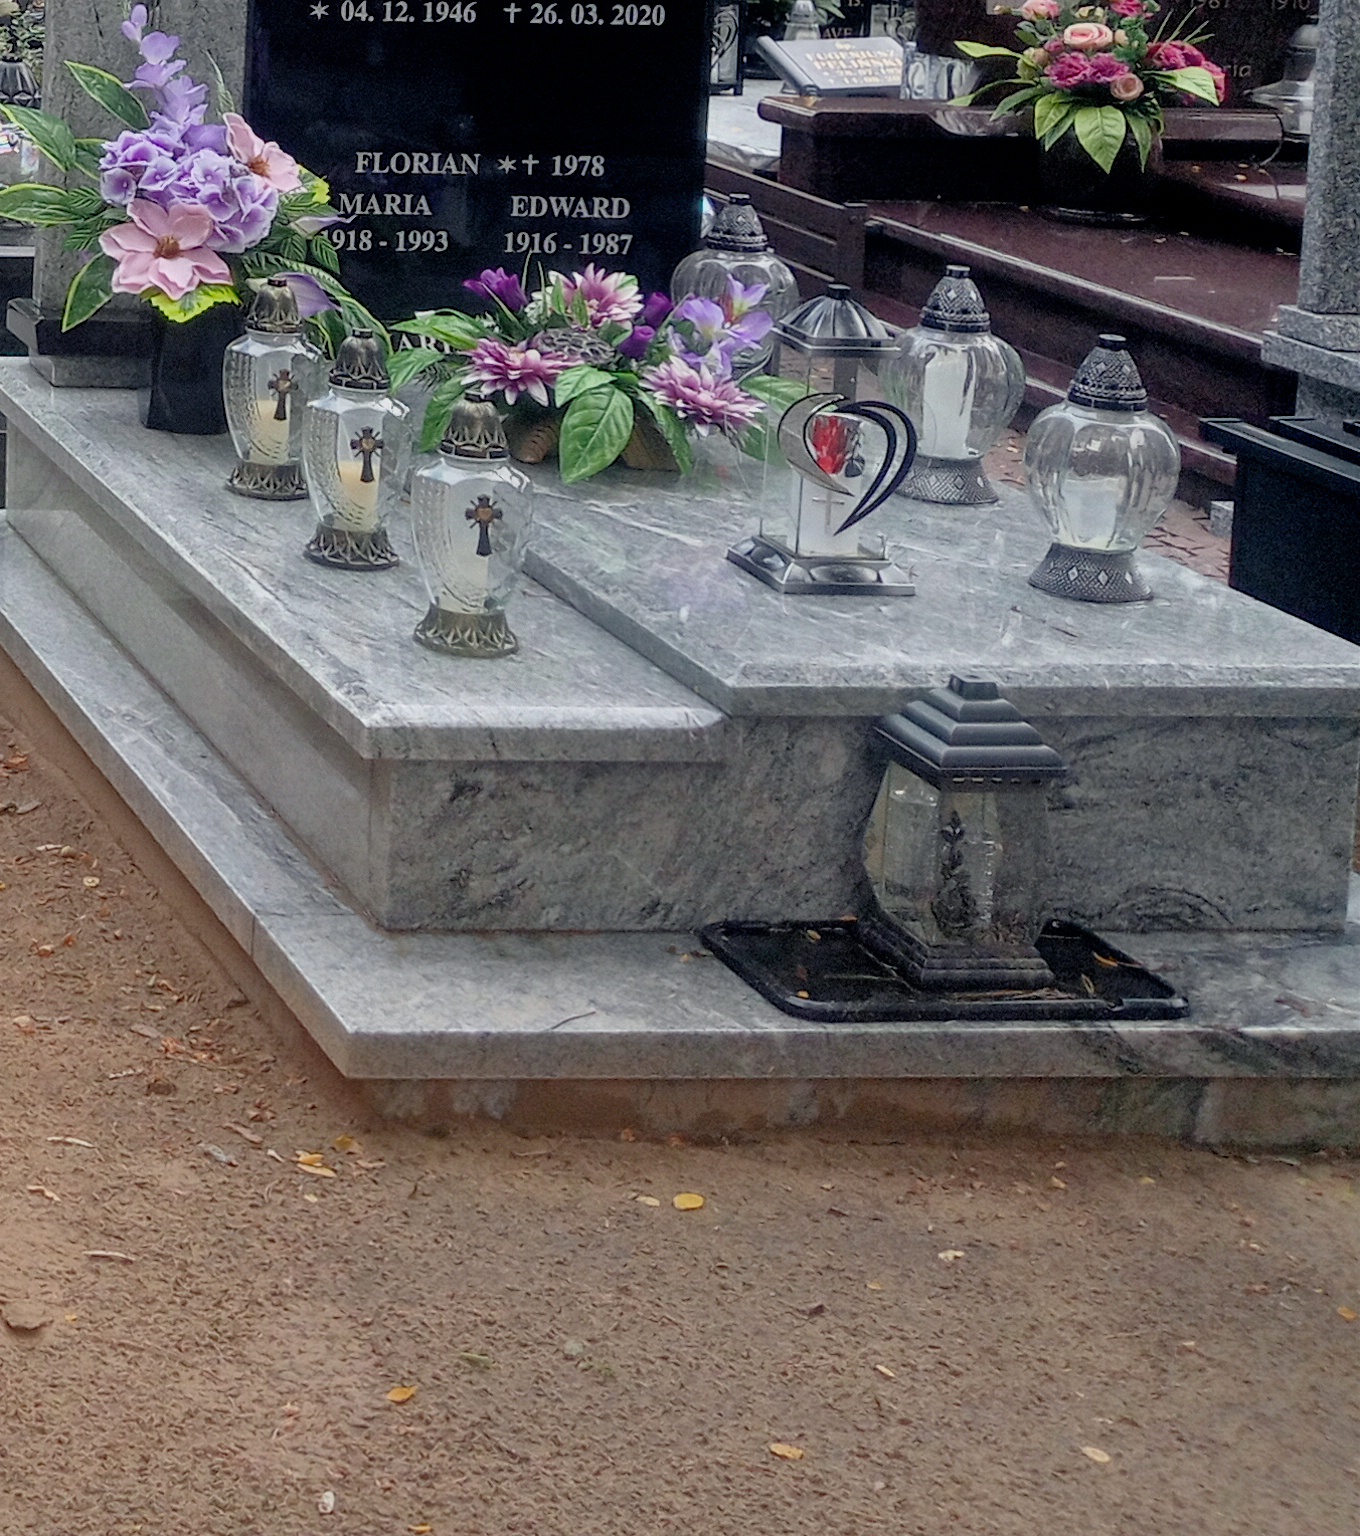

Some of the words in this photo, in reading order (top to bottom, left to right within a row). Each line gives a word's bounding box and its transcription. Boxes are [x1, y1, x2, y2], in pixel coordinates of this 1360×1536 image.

[340, 0, 375, 23] 04.
[382, 1, 415, 23] 12.
[422, 1, 478, 24] 1946
[529, 3, 564, 25] 26.
[570, 3, 605, 26] 03.
[610, 4, 666, 27] 2020
[354, 151, 481, 176] FLORIAN
[552, 155, 605, 177] 1978
[338, 193, 433, 216] MARIA
[510, 195, 631, 219] EDWARD
[395, 230, 449, 252] 1993
[503, 231, 558, 255] 1916
[578, 232, 634, 255] 1987
